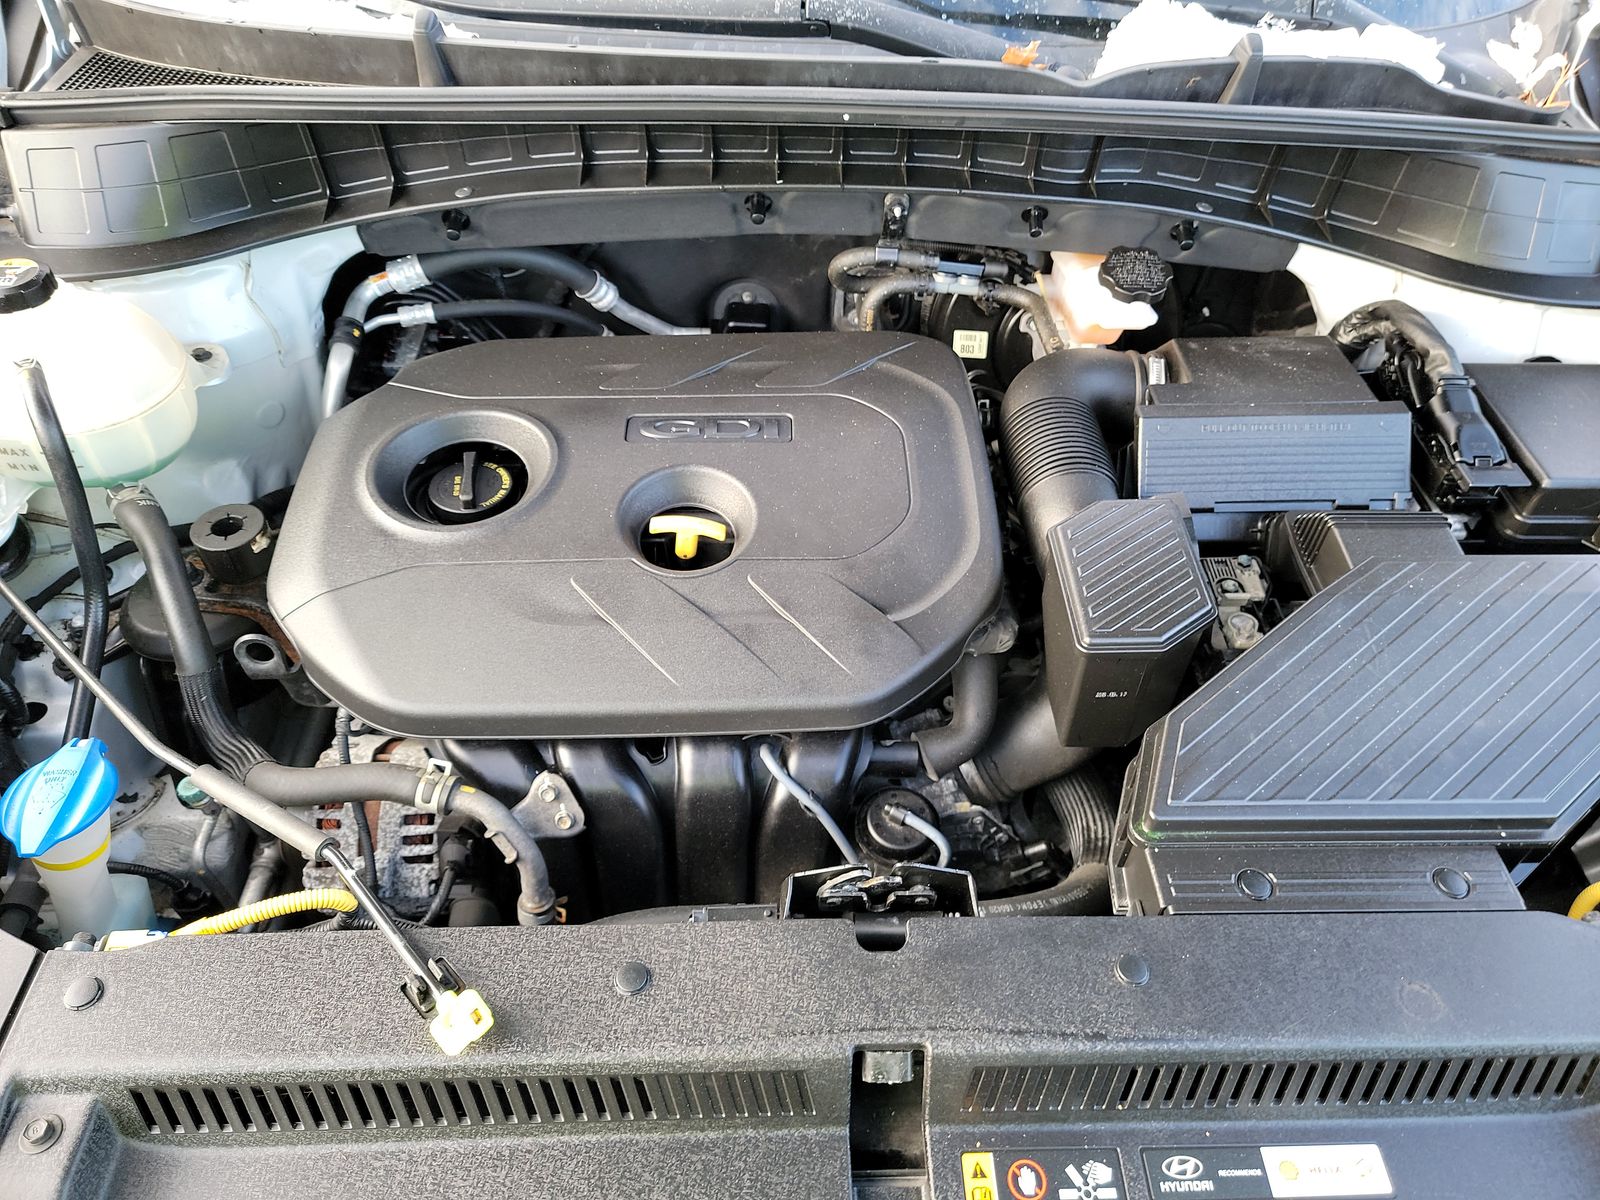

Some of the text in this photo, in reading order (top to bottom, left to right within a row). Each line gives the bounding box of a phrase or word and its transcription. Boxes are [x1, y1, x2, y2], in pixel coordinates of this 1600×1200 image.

[960, 344, 975, 354] 803
[640, 419, 779, 439] GDI
[0, 447, 30, 457] MAX
[7, 462, 40, 472] MIN
[1218, 1168, 1262, 1177] RECOMMENDS
[1159, 1180, 1214, 1192] HYUNDAI
